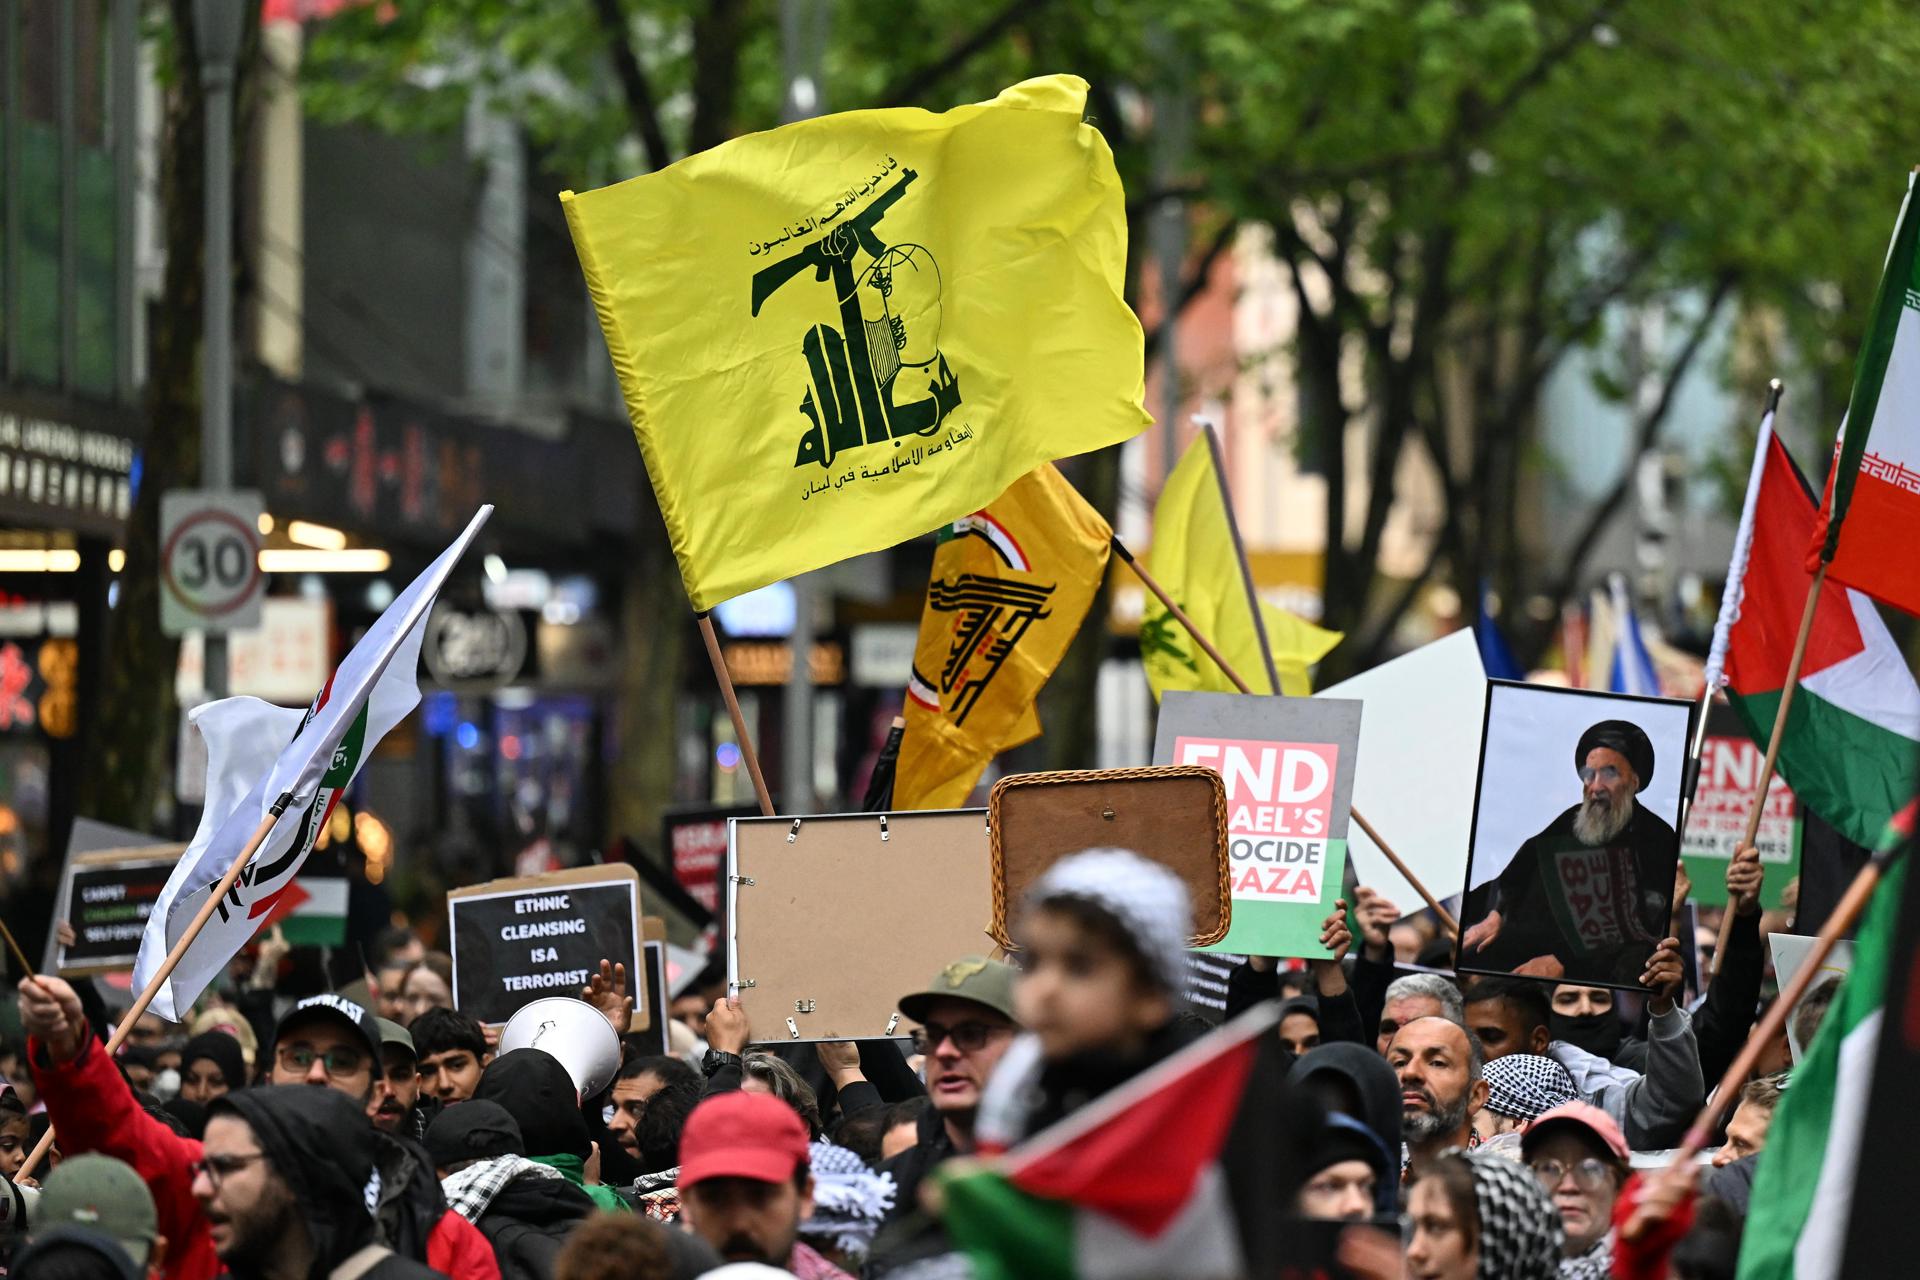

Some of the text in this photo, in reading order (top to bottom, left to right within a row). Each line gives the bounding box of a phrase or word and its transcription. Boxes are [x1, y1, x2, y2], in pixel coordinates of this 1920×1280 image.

[801, 474, 831, 501] لبنان
[834, 466, 856, 491] في
[180, 537, 248, 589] 30
[1229, 804, 1324, 835] AEL'S
[1230, 838, 1321, 865] OCIDE
[514, 894, 570, 914] ETHNIC
[501, 918, 586, 941] CLEANSING
[531, 947, 559, 964] IS A
[502, 969, 589, 992] TERRORIST
